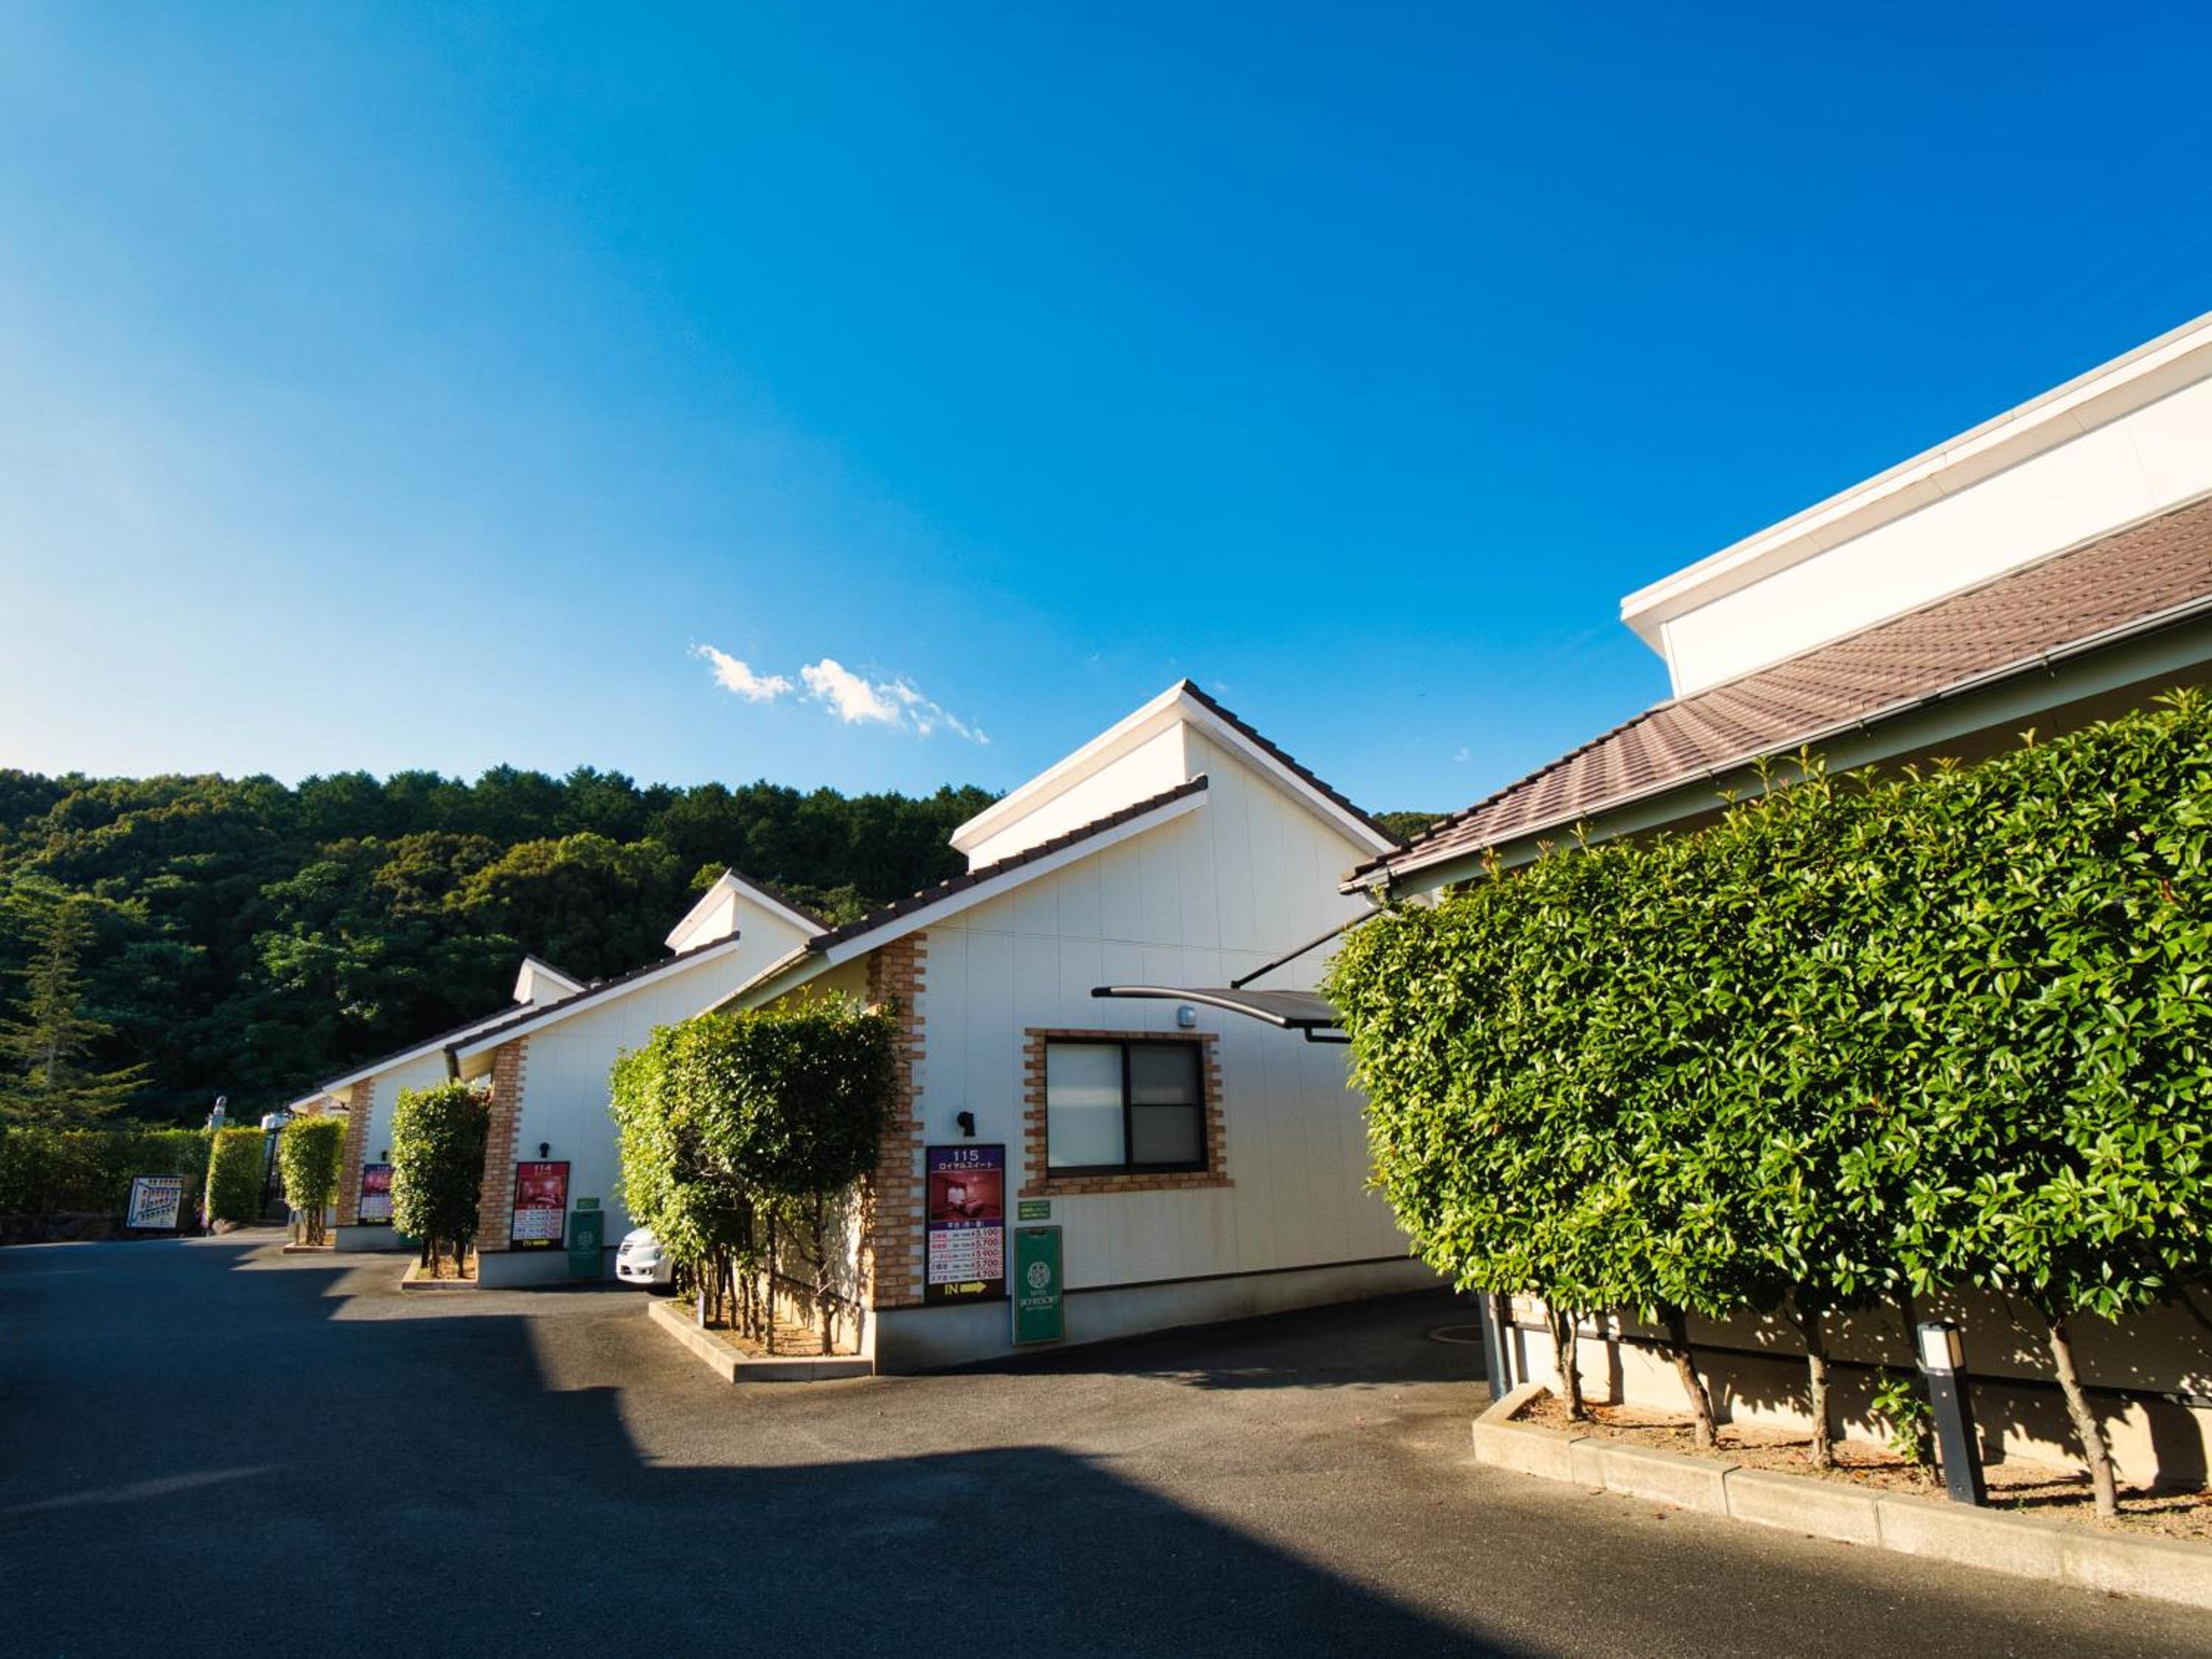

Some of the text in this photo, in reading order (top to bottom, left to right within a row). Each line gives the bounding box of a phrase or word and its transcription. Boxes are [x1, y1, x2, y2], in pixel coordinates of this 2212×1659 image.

[953, 1150, 979, 1161] 115
[535, 1165, 552, 1174] 114
[945, 1284, 959, 1295] IN
